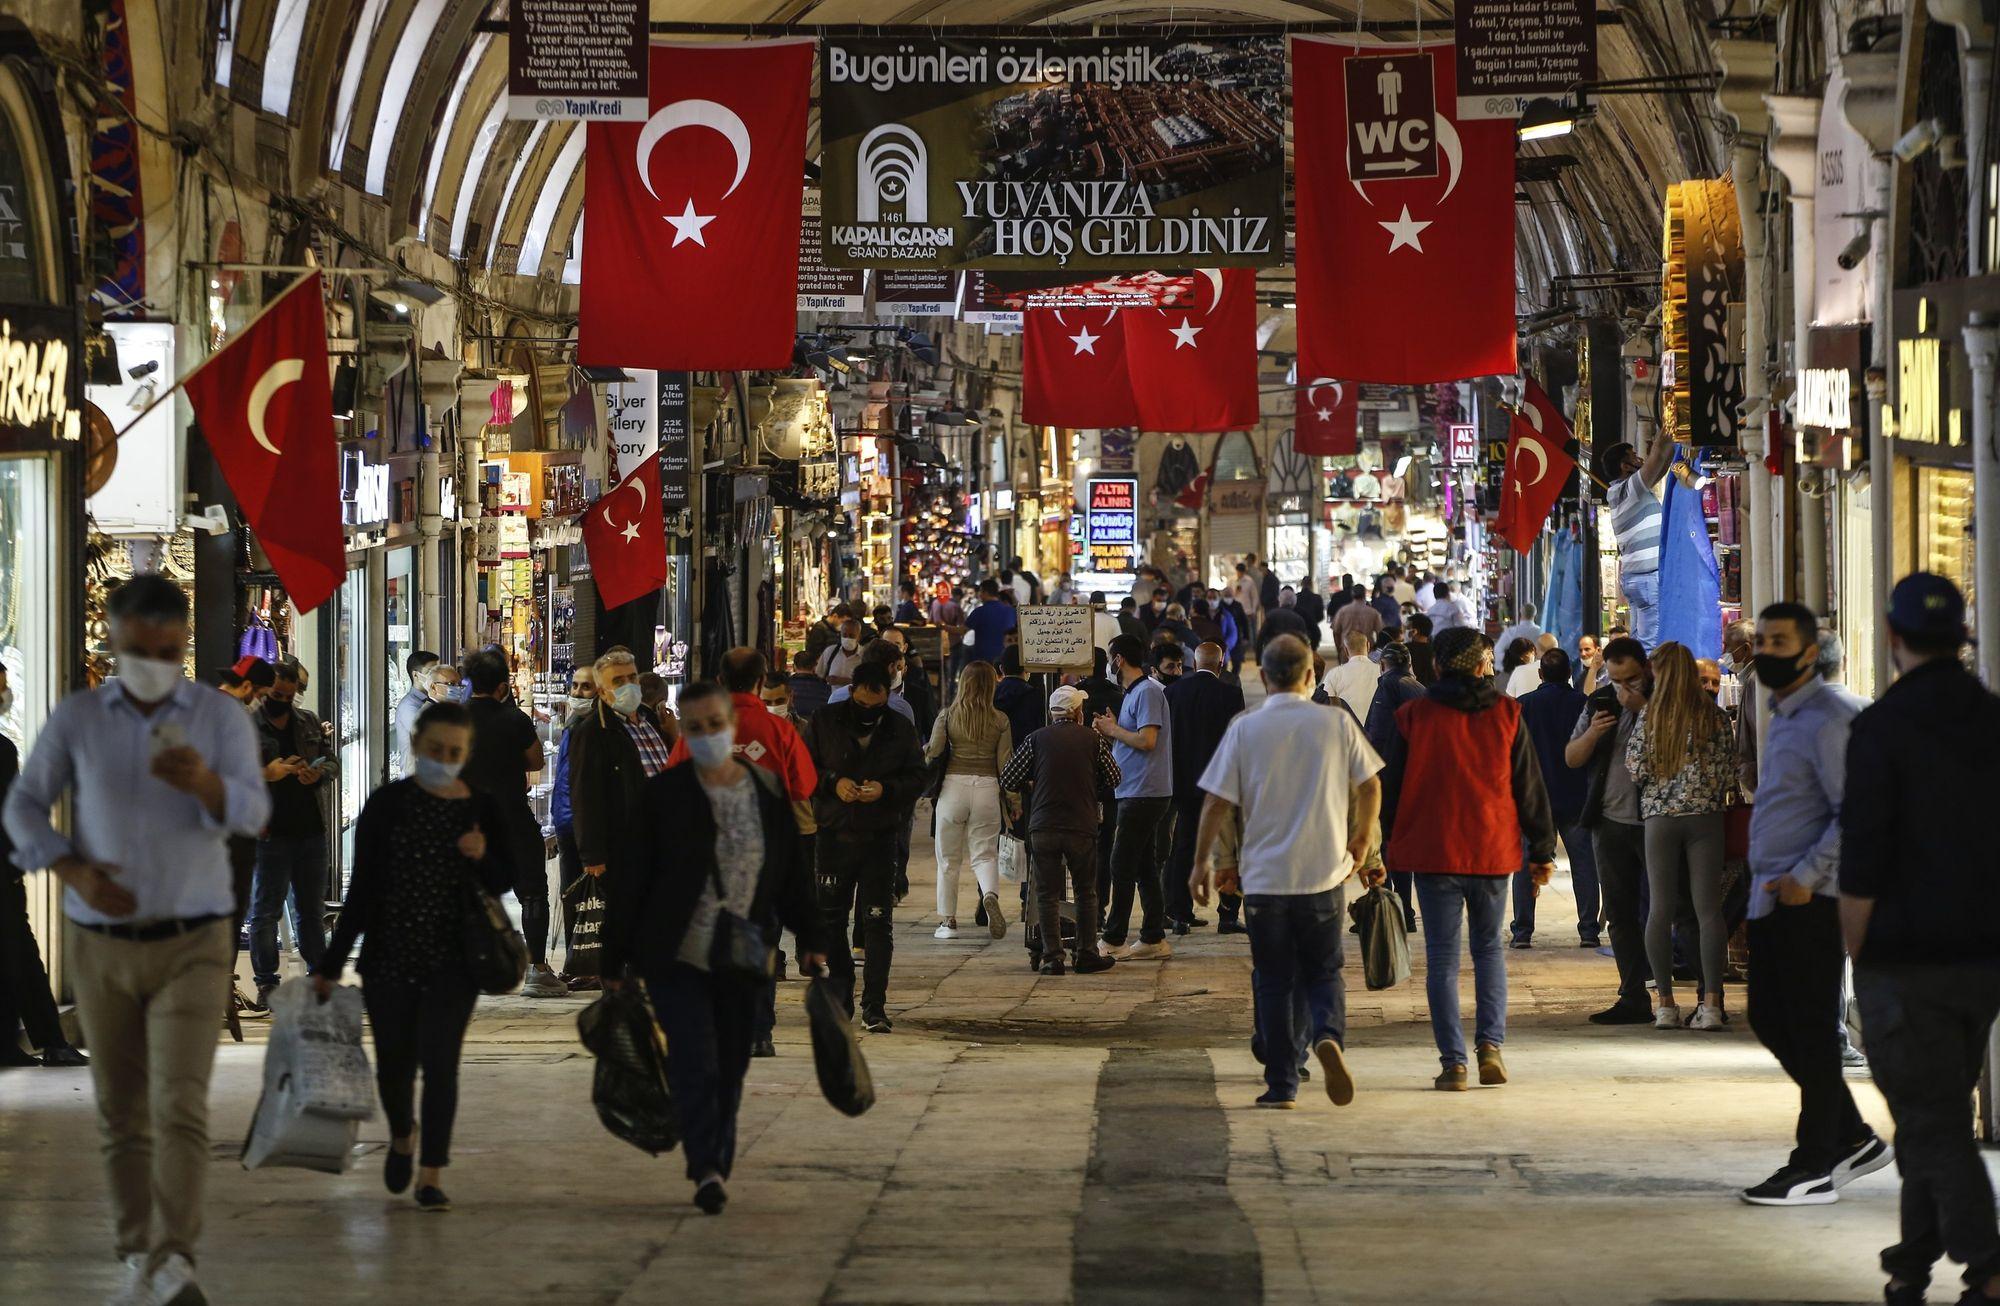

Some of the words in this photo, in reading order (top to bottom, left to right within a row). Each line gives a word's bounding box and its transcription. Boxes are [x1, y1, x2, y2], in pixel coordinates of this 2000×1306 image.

[522, 0, 550, 11] Grand
[552, 1, 585, 11] Bazaar
[587, 3, 608, 11] was
[610, 1, 638, 12] home
[1473, 4, 1511, 14] zamana
[1513, 2, 1541, 13] kadar
[1543, 1, 1549, 11] 5
[1551, 1, 1578, 12] cami,
[524, 13, 534, 21] to
[600, 14, 635, 25] school,
[1475, 17, 1499, 29] okul,
[1500, 17, 1505, 27] 7
[1507, 17, 1542, 29] çeşme,
[1544, 15, 1554, 25] 10
[1556, 14, 1583, 26] kuyu,
[529, 23, 534, 33] 7
[537, 23, 587, 35] fountains,
[589, 24, 599, 34] 10
[601, 24, 629, 35] wells,
[532, 36, 562, 44] water
[564, 35, 612, 48] dispenser
[614, 36, 633, 46] and
[1494, 31, 1519, 43] dere,
[1527, 29, 1551, 40] sebil
[1553, 31, 1564, 39] ve
[539, 46, 579, 56] ablution
[582, 46, 626, 57] fountain.
[1464, 46, 1469, 56] 1
[1471, 45, 1512, 59] şadırvan
[1515, 42, 1589, 55] bulunmaktaydı.
[528, 57, 557, 69] Today
[560, 57, 580, 69] only
[590, 59, 630, 69] mosque,
[829, 46, 988, 92] Bugünleri
[996, 47, 1190, 91] özlemiştik...
[1475, 59, 1505, 72] Bugün
[1514, 58, 1540, 70] cami,
[1542, 57, 1579, 71] 7çeşme
[526, 68, 569, 78] fountain
[570, 69, 589, 78] and
[597, 69, 638, 79] ablution
[1472, 75, 1484, 85] ve
[1492, 72, 1534, 86] şadırvan
[1536, 71, 1583, 84] kalmıştır.
[537, 80, 579, 90] fountain
[581, 82, 598, 90] are
[600, 80, 621, 91] left.
[1355, 118, 1430, 155] WC
[955, 180, 1155, 218] YUVANIZA
[882, 212, 903, 223] 1461
[992, 216, 1074, 265] HOŞ
[1081, 207, 1271, 255] GELDİNİZ
[848, 246, 888, 258] GRAND
[891, 247, 937, 259] BAZAAR
[819, 273, 836, 282] hans
[837, 274, 854, 282] were
[823, 282, 837, 290] into
[837, 282, 845, 290] it.
[607, 393, 646, 409] Siver
[663, 419, 682, 427] 22K
[1095, 484, 1129, 495] ALTIN
[1092, 497, 1131, 508] ALINIR
[1090, 513, 1134, 529] GÜMÜŞ
[1092, 528, 1131, 540] ALINIR
[1096, 557, 1128, 570] ALINIR
